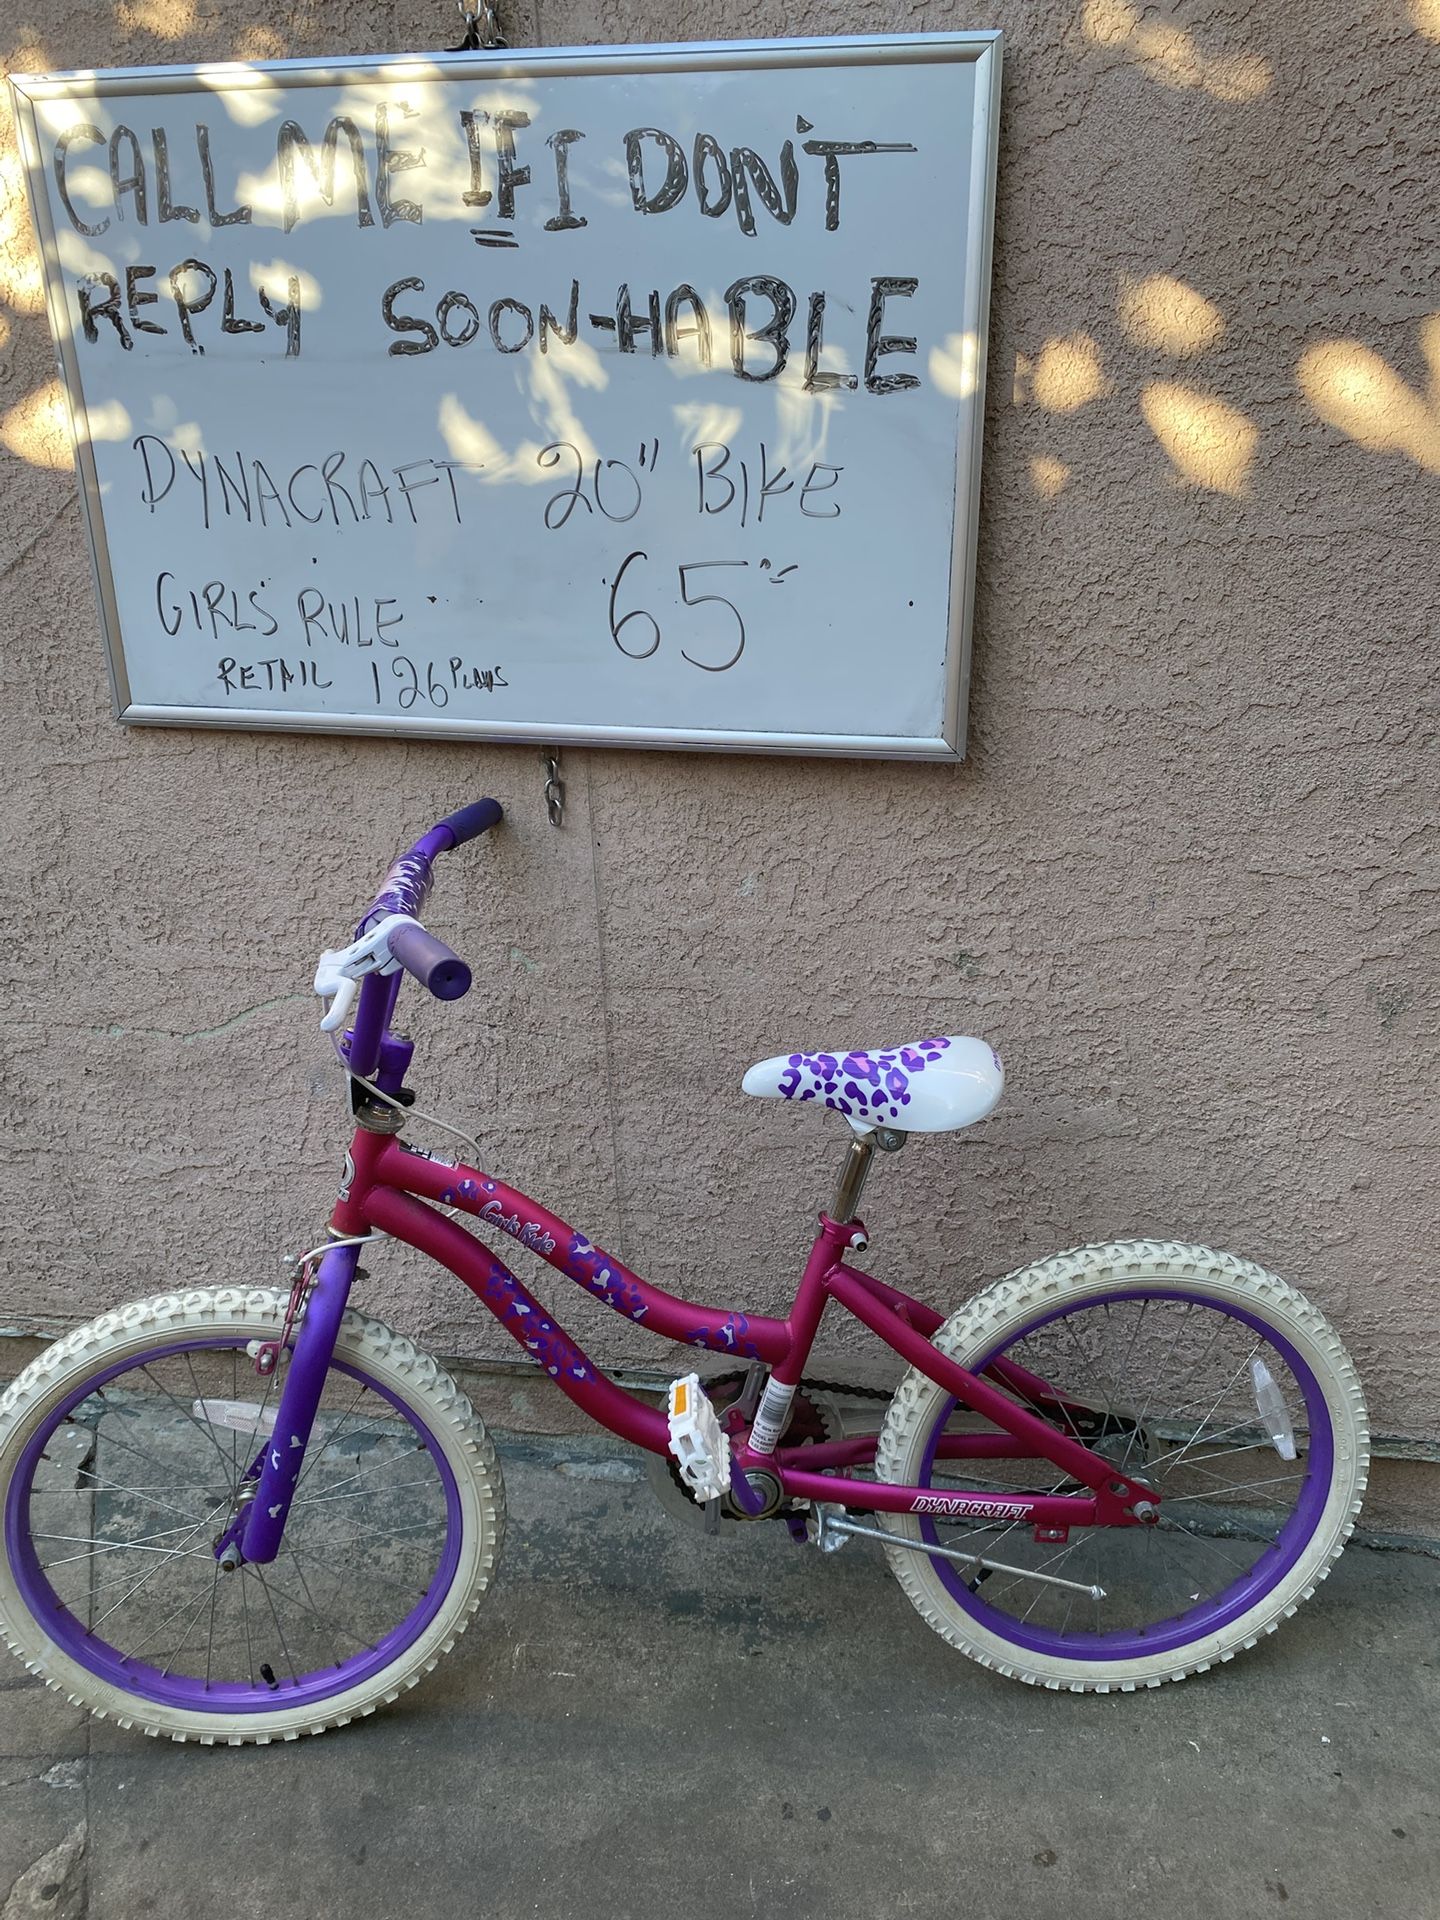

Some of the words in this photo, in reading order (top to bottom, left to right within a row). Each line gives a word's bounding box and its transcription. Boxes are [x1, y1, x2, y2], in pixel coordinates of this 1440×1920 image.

[54, 123, 253, 238] CALL
[277, 102, 428, 234] ME
[459, 108, 532, 220] IF
[543, 128, 588, 232] I
[76, 257, 302, 359] REPLY
[132, 434, 486, 530] DYNACRAFT
[297, 585, 404, 648] RULE
[216, 655, 334, 696] RETAIL
[371, 655, 449, 710] 126
[909, 1495, 1035, 1520] DYNACRAFT
